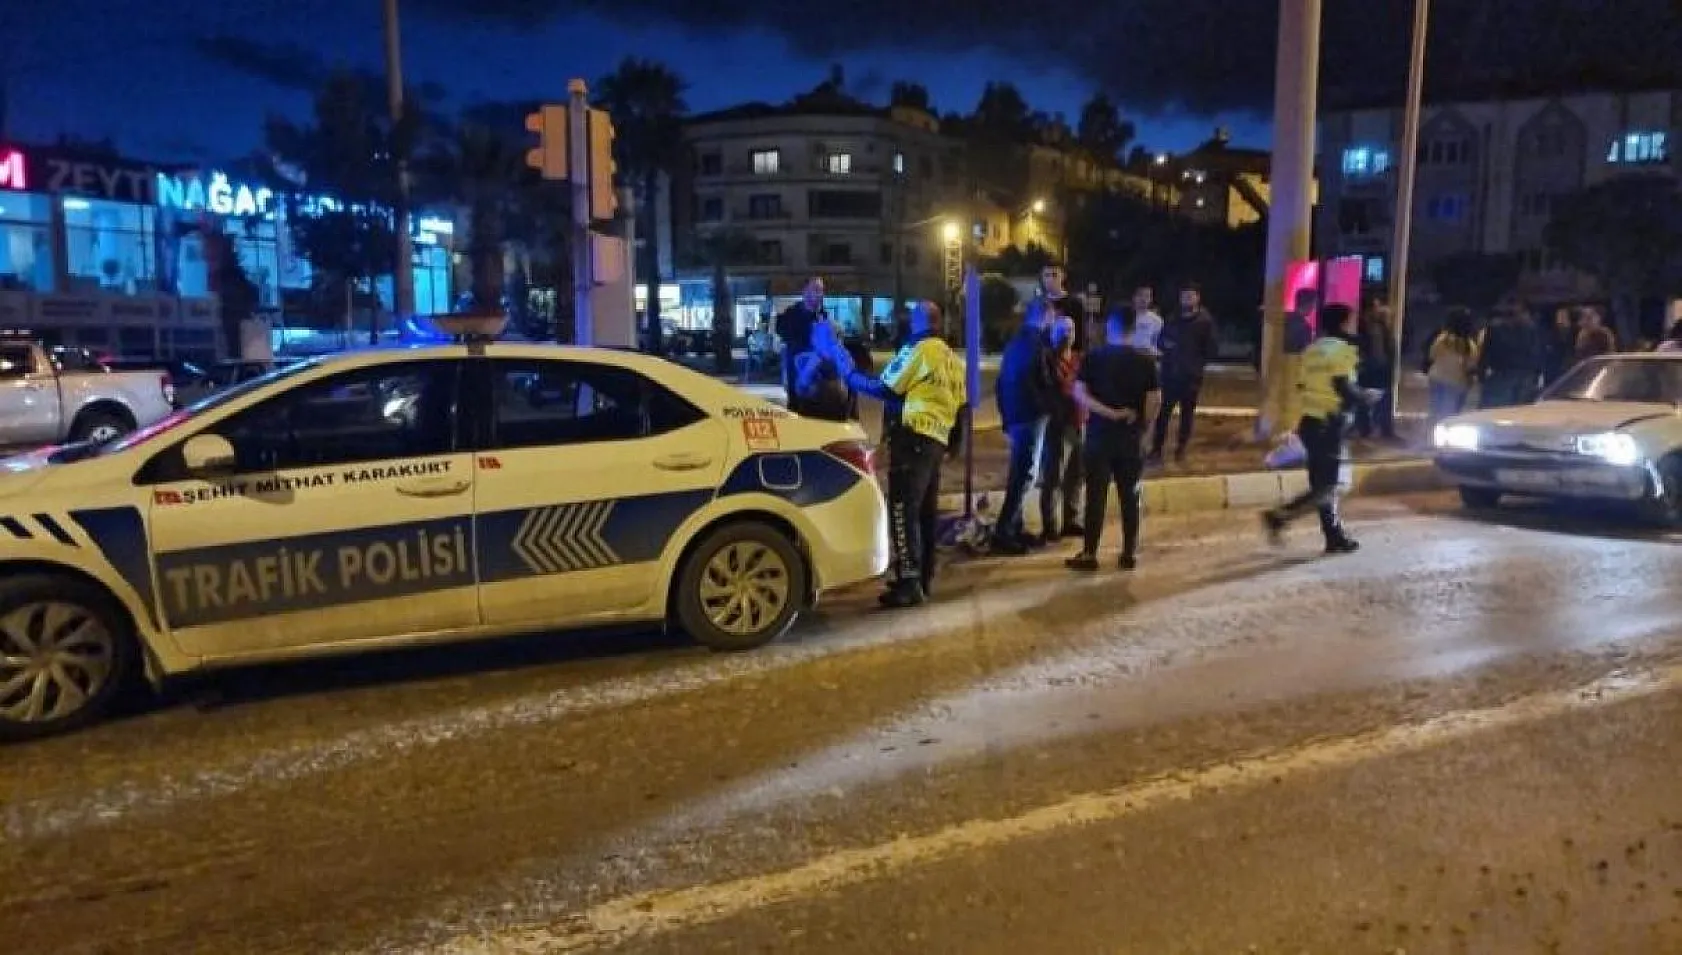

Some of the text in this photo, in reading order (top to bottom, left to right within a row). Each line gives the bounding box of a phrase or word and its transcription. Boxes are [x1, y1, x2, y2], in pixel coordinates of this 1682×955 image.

[343, 460, 452, 483] KARAKURT
[166, 526, 468, 612] TRAFİK POLİSİ
